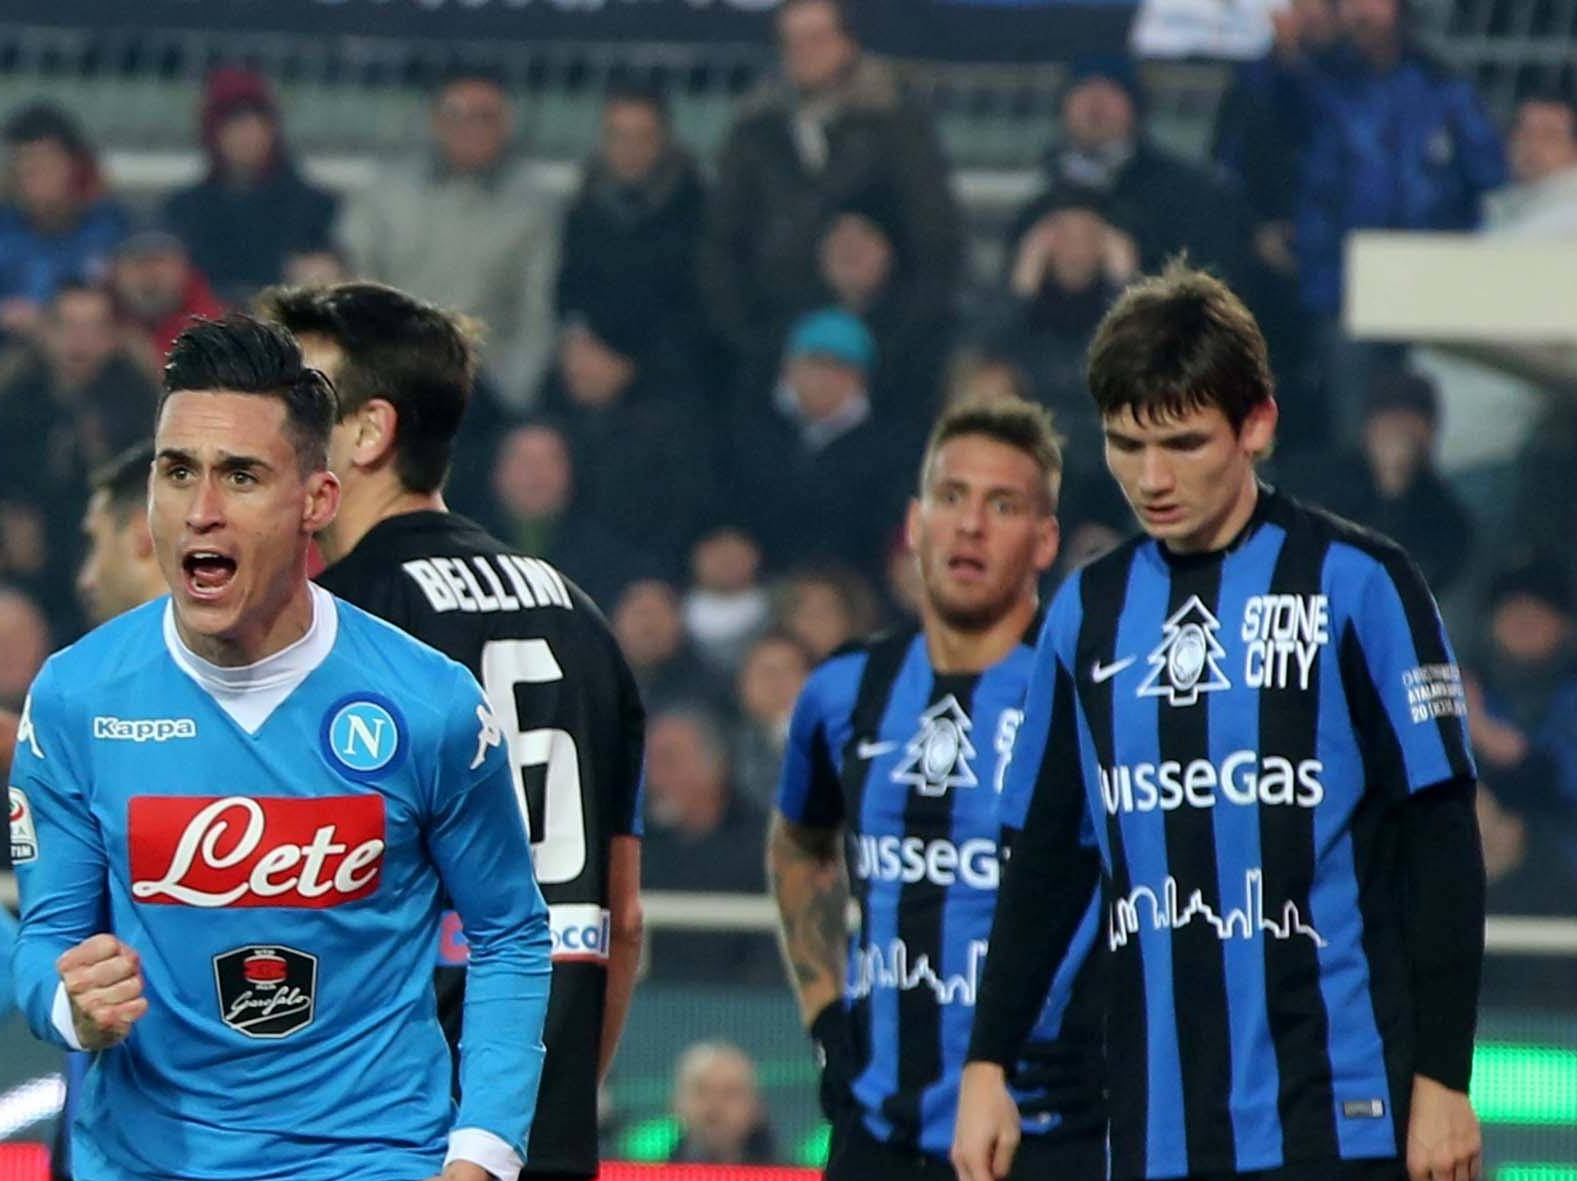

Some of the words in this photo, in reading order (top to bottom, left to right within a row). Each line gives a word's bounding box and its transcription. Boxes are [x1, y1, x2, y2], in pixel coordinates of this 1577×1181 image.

[403, 554, 573, 613] BELLINI
[1241, 593, 1329, 643] STONE
[1245, 639, 1320, 690] CITY
[93, 717, 197, 742] Kappa
[343, 714, 386, 759] N
[482, 637, 587, 885] 6
[1098, 749, 1325, 815] uisseGas
[131, 796, 386, 908] Lete
